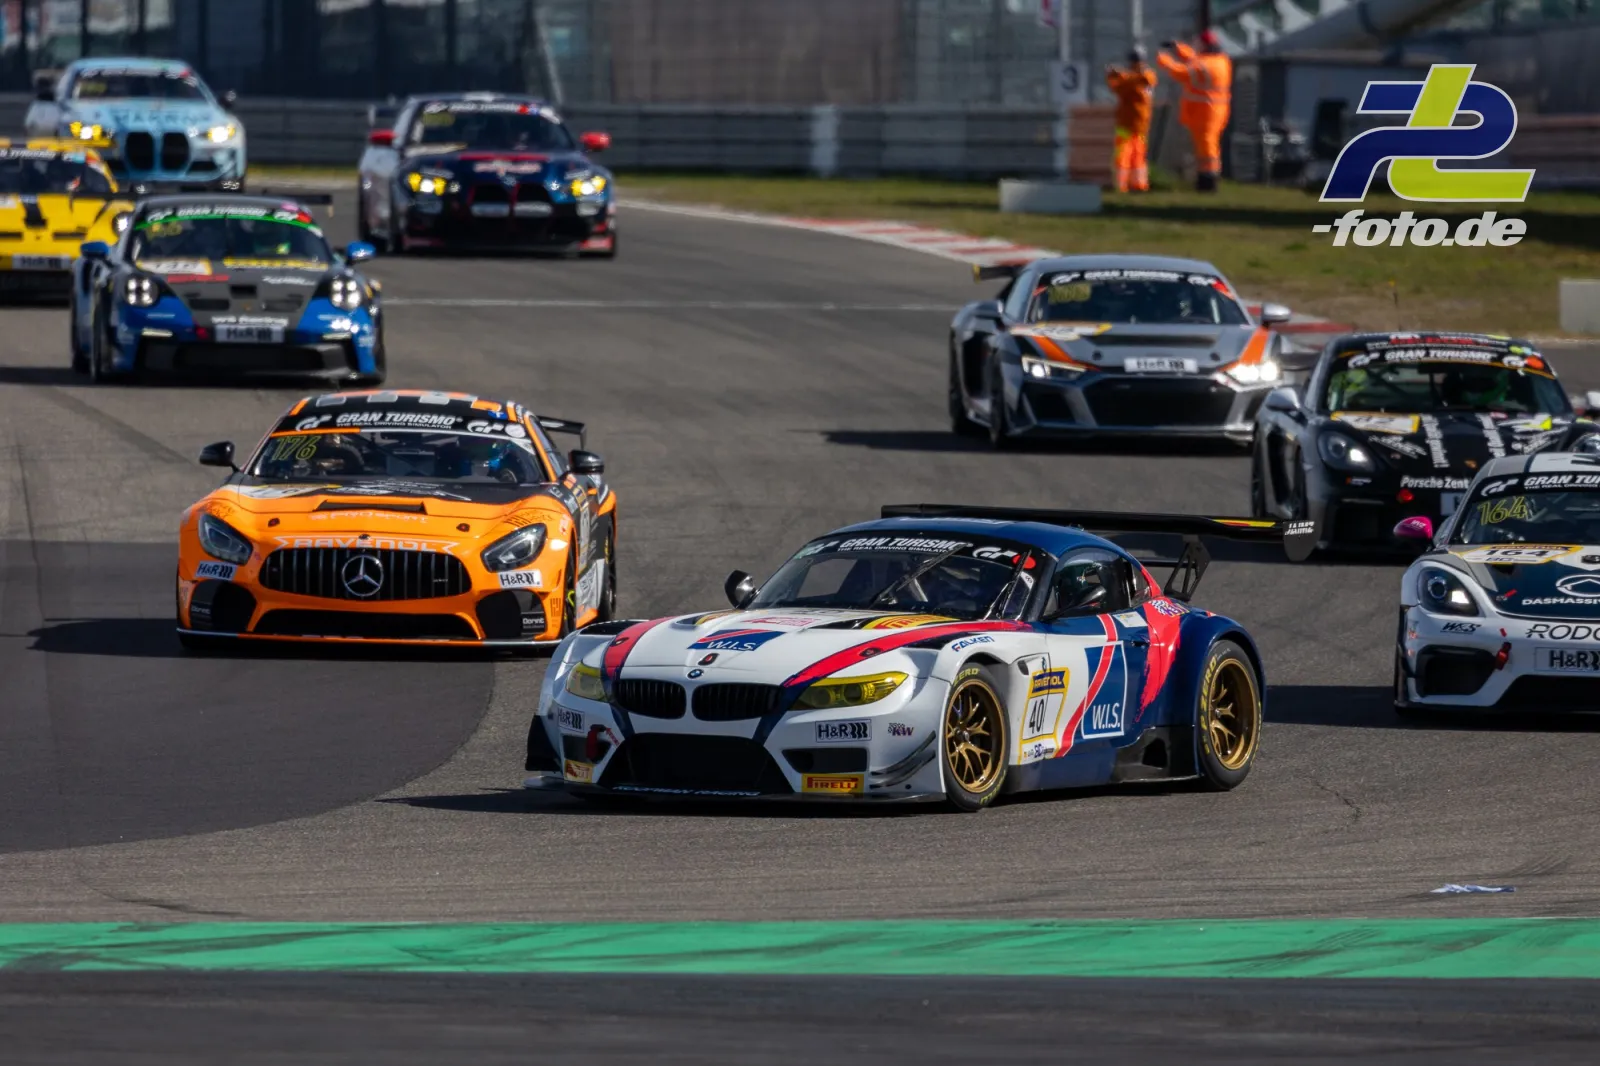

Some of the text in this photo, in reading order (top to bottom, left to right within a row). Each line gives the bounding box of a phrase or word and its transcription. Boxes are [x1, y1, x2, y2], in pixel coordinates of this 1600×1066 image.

[1061, 65, 1078, 93] 3
[1385, 349, 1426, 361] GRAN
[336, 412, 382, 423] GRAN
[385, 411, 459, 427] TURISMO
[272, 435, 322, 461] 176
[1400, 475, 1470, 489] Porsche Zent
[1524, 475, 1573, 486] GRAN
[1476, 495, 1528, 526] 164
[838, 537, 888, 549] GRAN
[951, 635, 995, 653] FALKEN
[1028, 698, 1044, 734] 40
[1091, 703, 1121, 731] W.I.S.
[806, 776, 859, 789] PIRELLI
